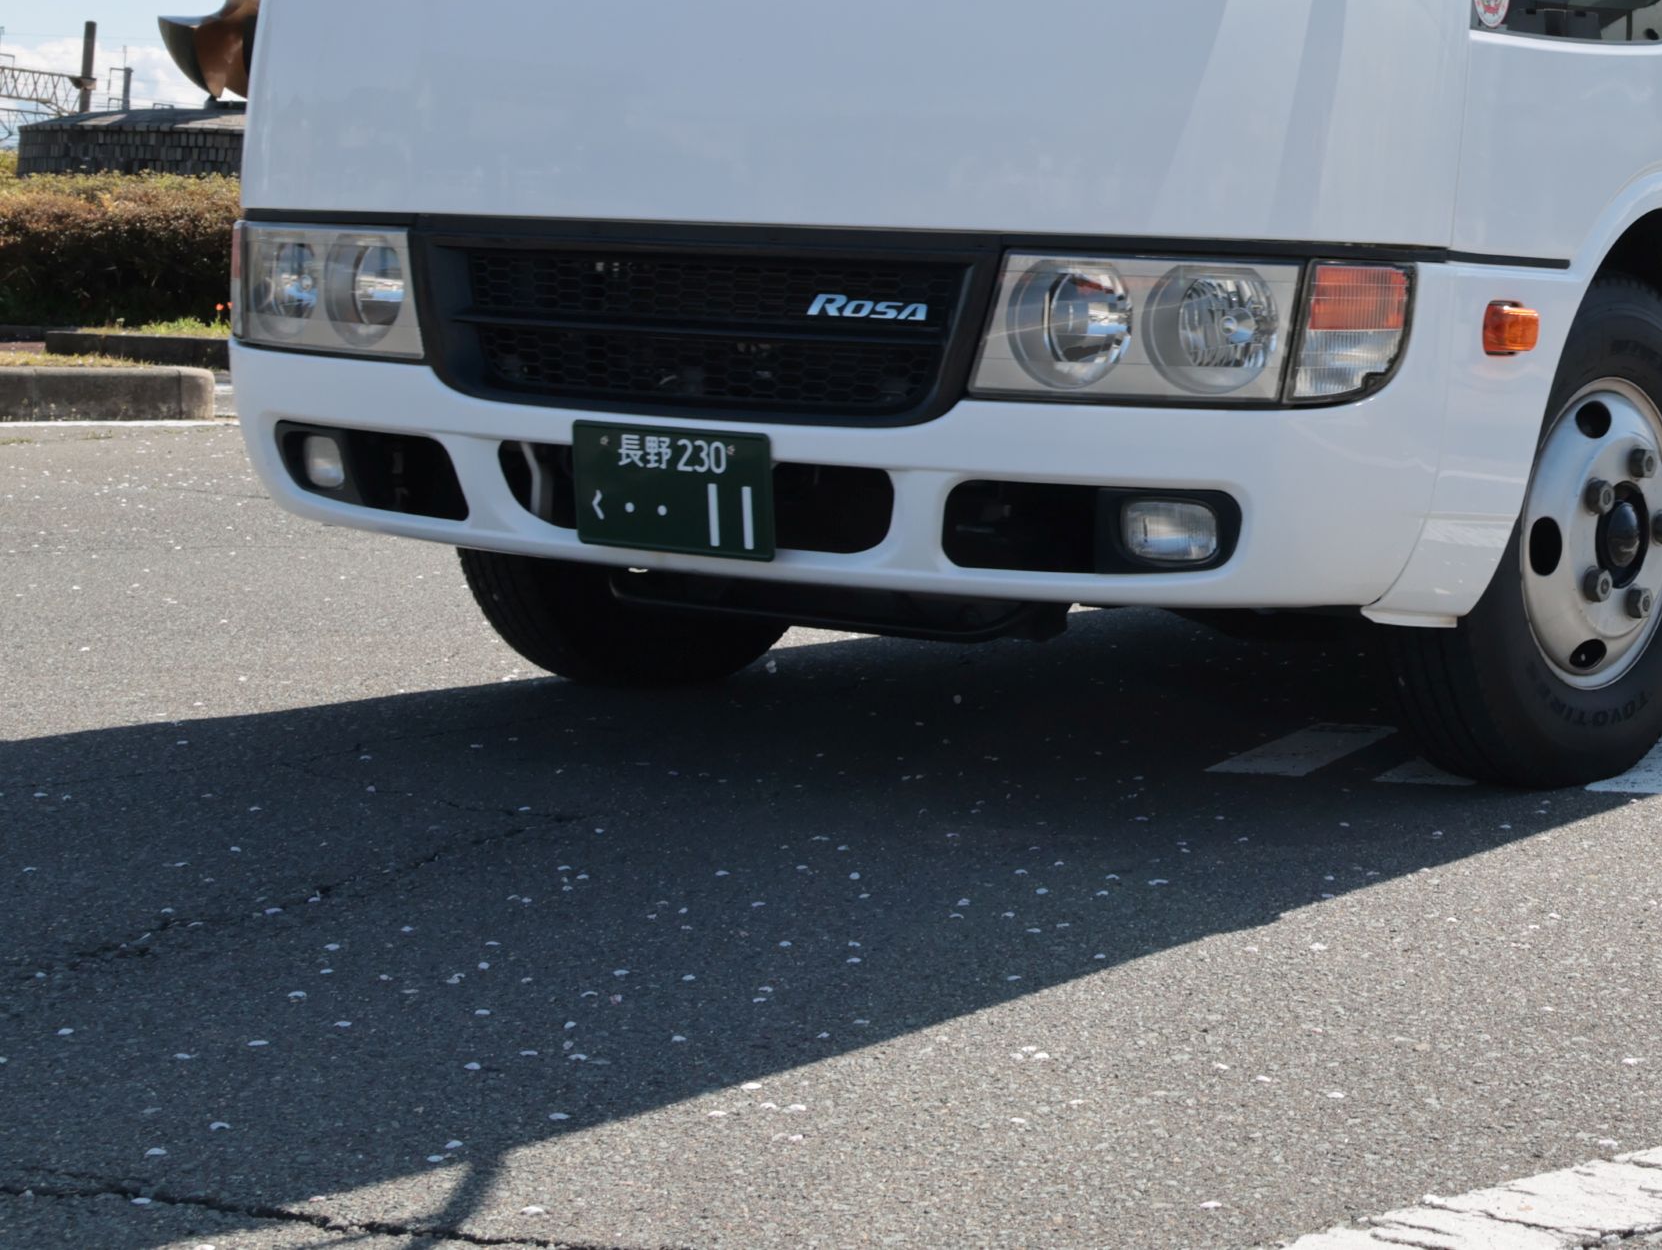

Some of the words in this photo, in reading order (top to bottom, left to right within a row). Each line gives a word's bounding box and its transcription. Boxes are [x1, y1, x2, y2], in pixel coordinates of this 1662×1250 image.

[807, 293, 929, 321] ROSA
[618, 434, 672, 469] 長野
[676, 438, 727, 474] 230
